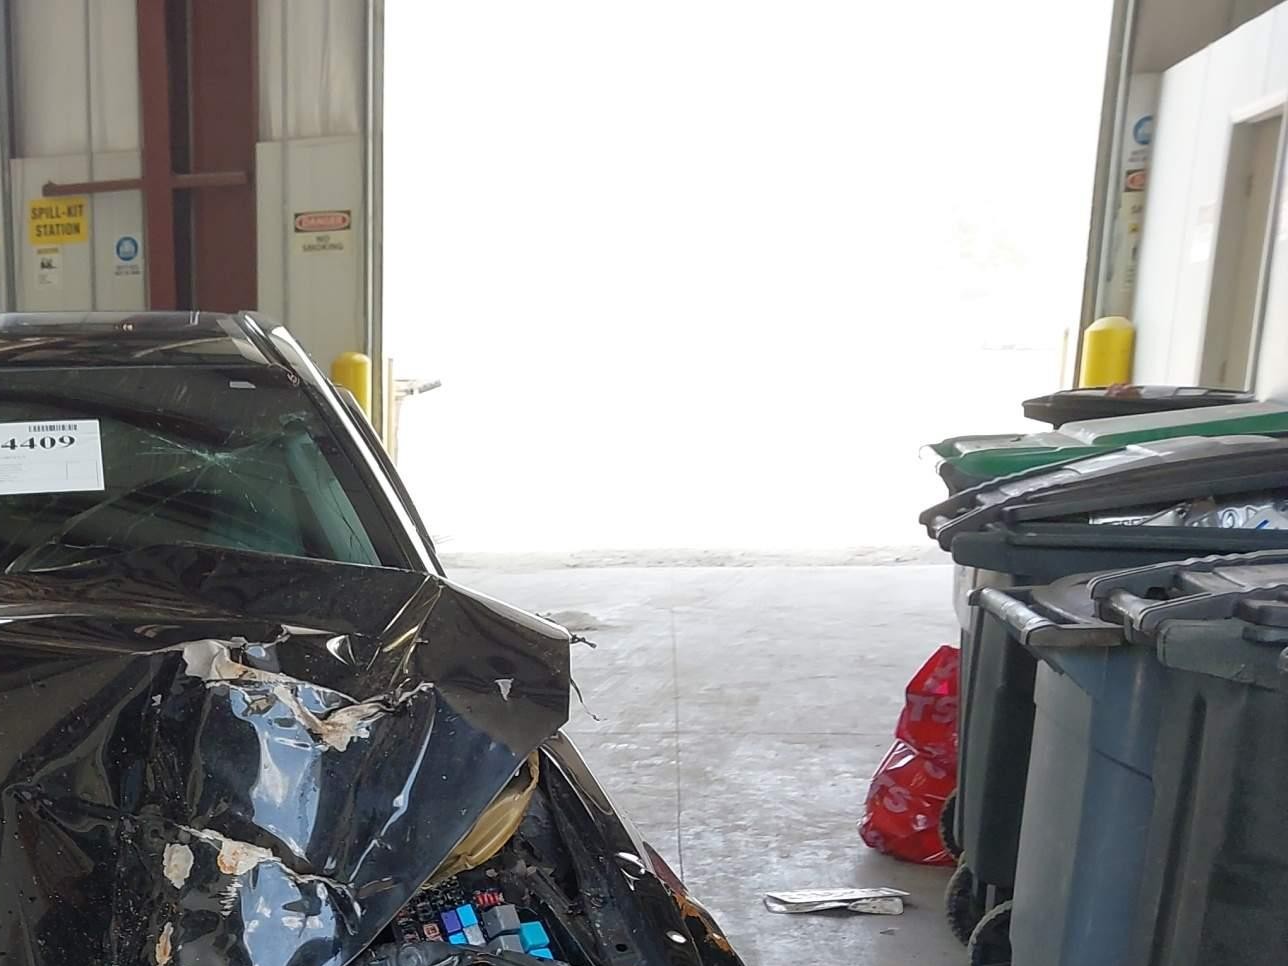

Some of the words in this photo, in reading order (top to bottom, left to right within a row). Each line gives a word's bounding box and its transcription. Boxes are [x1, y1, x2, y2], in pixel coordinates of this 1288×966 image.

[30, 204, 85, 220] SPILL-KIT
[35, 222, 81, 237] STATION
[315, 235, 330, 243] NO
[302, 242, 344, 251] SMOKING
